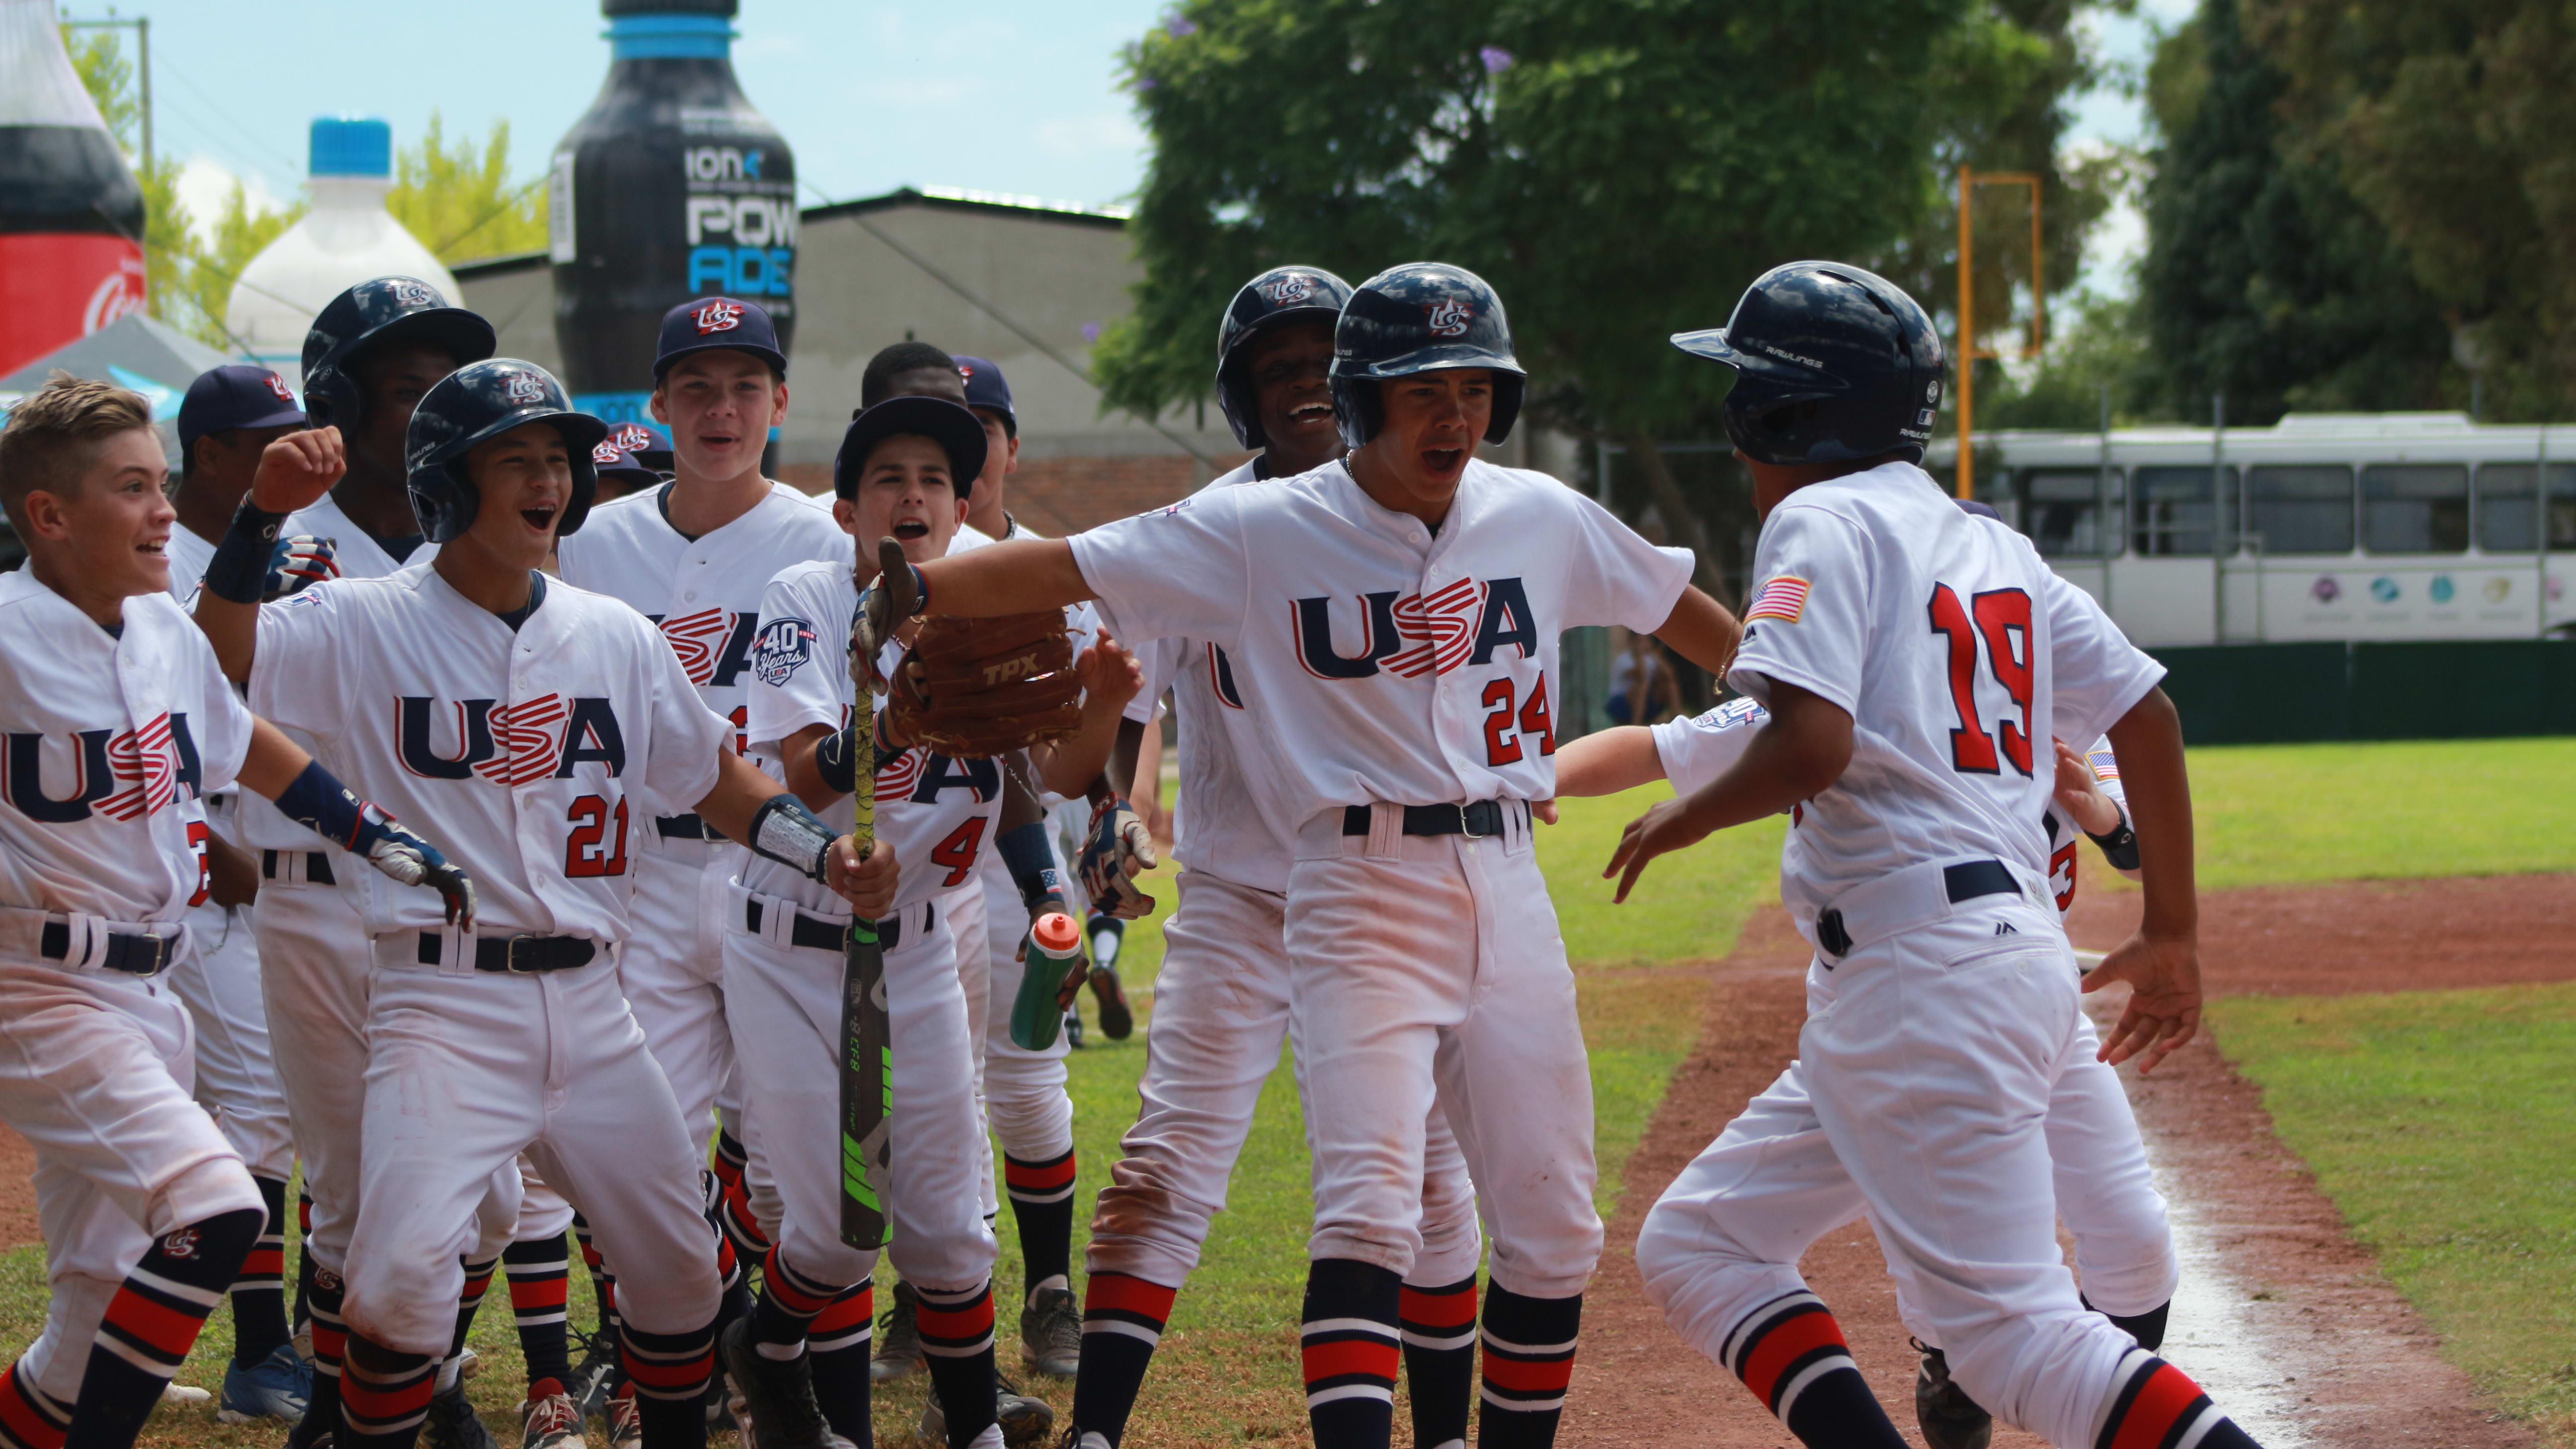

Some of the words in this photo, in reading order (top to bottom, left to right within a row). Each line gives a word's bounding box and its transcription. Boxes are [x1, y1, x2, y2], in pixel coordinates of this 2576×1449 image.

[689, 248, 791, 295] ADE
[1766, 346, 1823, 368] RAWLINGS
[759, 650, 804, 680] Years
[763, 623, 799, 655] 40
[1289, 576, 1537, 680] USA
[983, 652, 1040, 686] TPX
[1928, 581, 2034, 780] 19
[394, 692, 625, 788] USA
[1481, 670, 1555, 768] 24
[1, 711, 202, 823] USA
[565, 794, 629, 878] 21
[931, 816, 988, 887] 4
